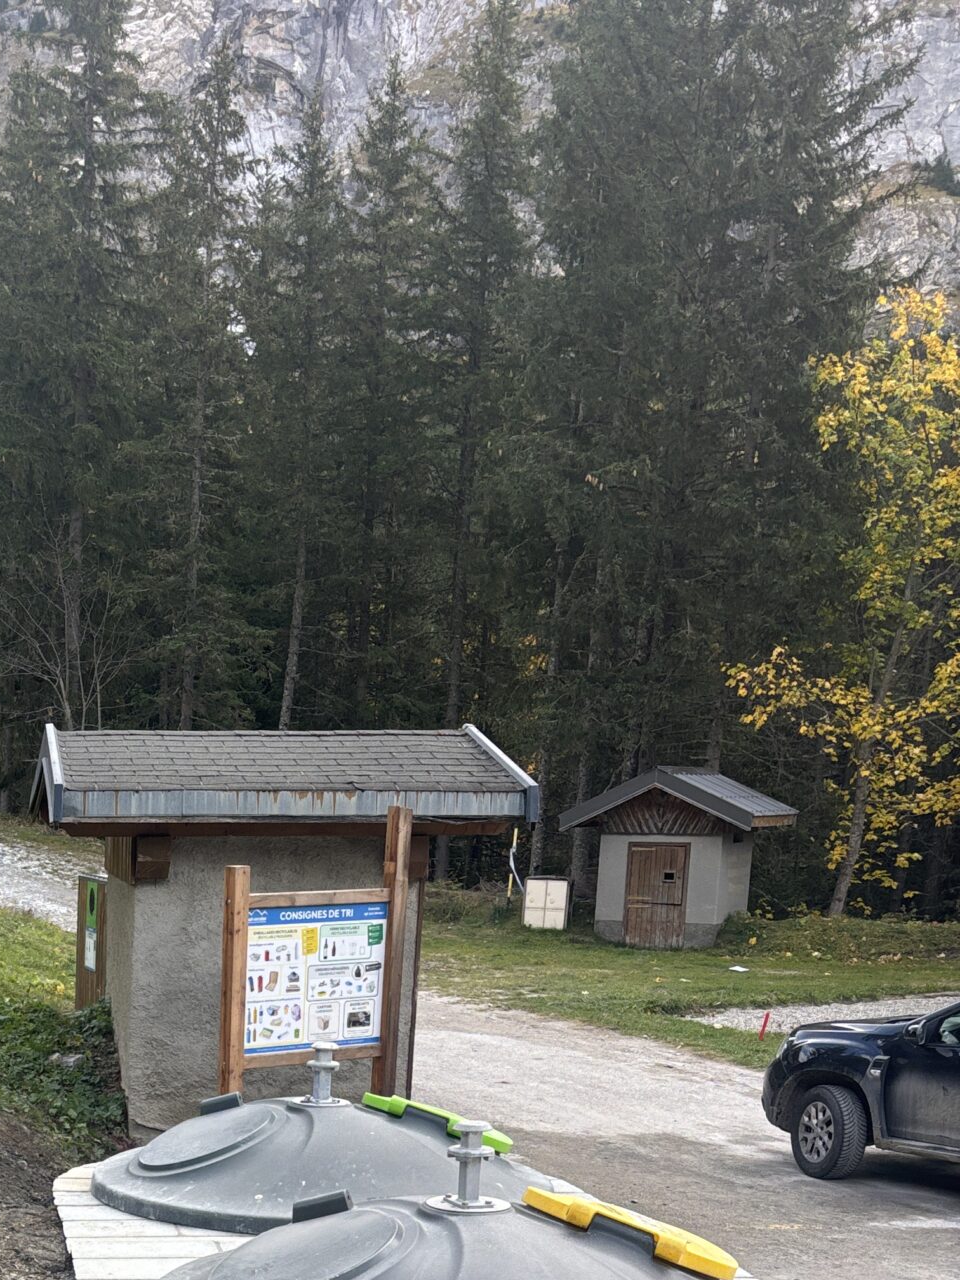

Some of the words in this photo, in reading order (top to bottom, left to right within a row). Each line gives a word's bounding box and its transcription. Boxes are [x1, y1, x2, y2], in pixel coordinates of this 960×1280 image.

[280, 910, 327, 920] CONSIGNES
[329, 909, 339, 918] DE
[341, 908, 353, 917] TRI
